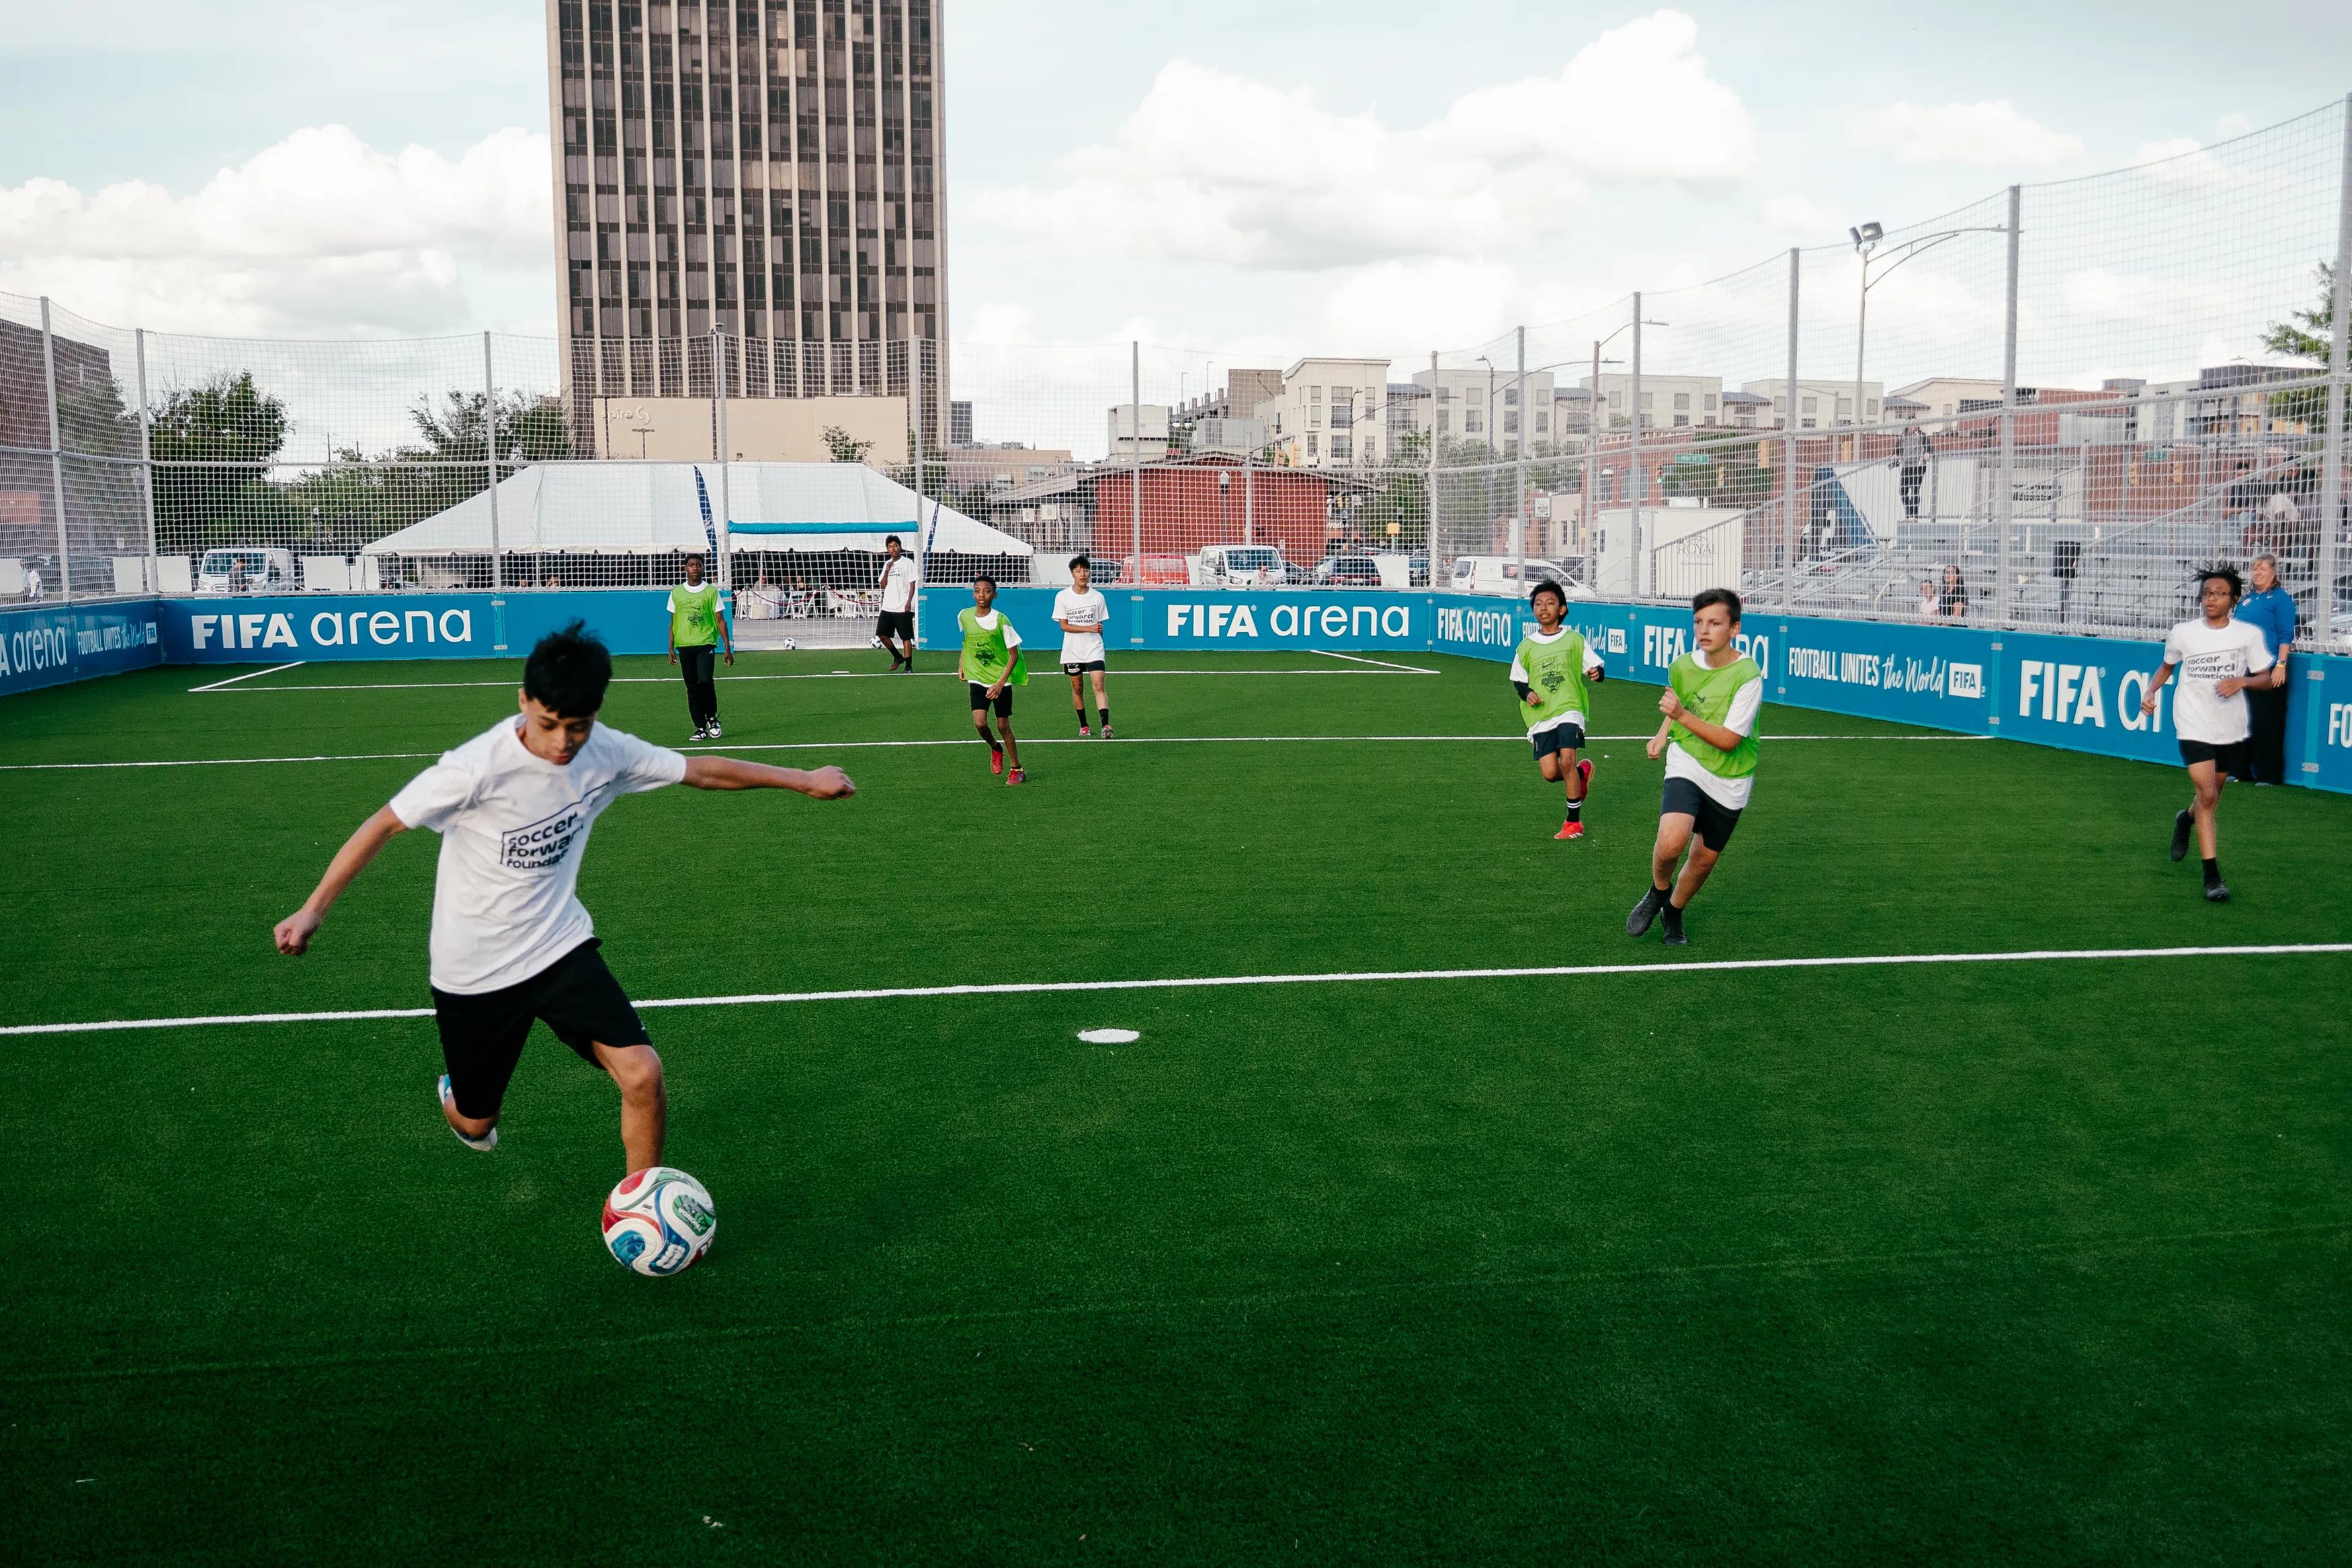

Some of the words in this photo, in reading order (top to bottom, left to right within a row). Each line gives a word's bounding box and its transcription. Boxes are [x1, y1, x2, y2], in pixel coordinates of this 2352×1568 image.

[601, 408, 633, 422] spire
[192, 615, 298, 650] FIFA
[310, 609, 471, 646] arena
[1167, 605, 1258, 638] FIFA
[1270, 605, 1409, 638] arena
[1437, 607, 1464, 642] FIFA
[1466, 609, 1511, 647] arena
[13, 626, 67, 673] arena
[77, 629, 103, 656] FOOTBALL
[103, 625, 121, 650] UNITES
[1586, 623, 1607, 655] World
[1610, 634, 1623, 648] FIFA
[1644, 625, 1686, 668] FIFA
[1789, 647, 1838, 681] FOOTBALL
[1841, 652, 1880, 687] UNITES
[1882, 653, 1904, 690] the
[1905, 655, 1947, 699] World
[2187, 655, 2220, 665] soccer
[2187, 663, 2235, 672] forward
[1952, 670, 1976, 690] FIFA
[2019, 659, 2106, 728] FIFA
[508, 811, 578, 848] soccer
